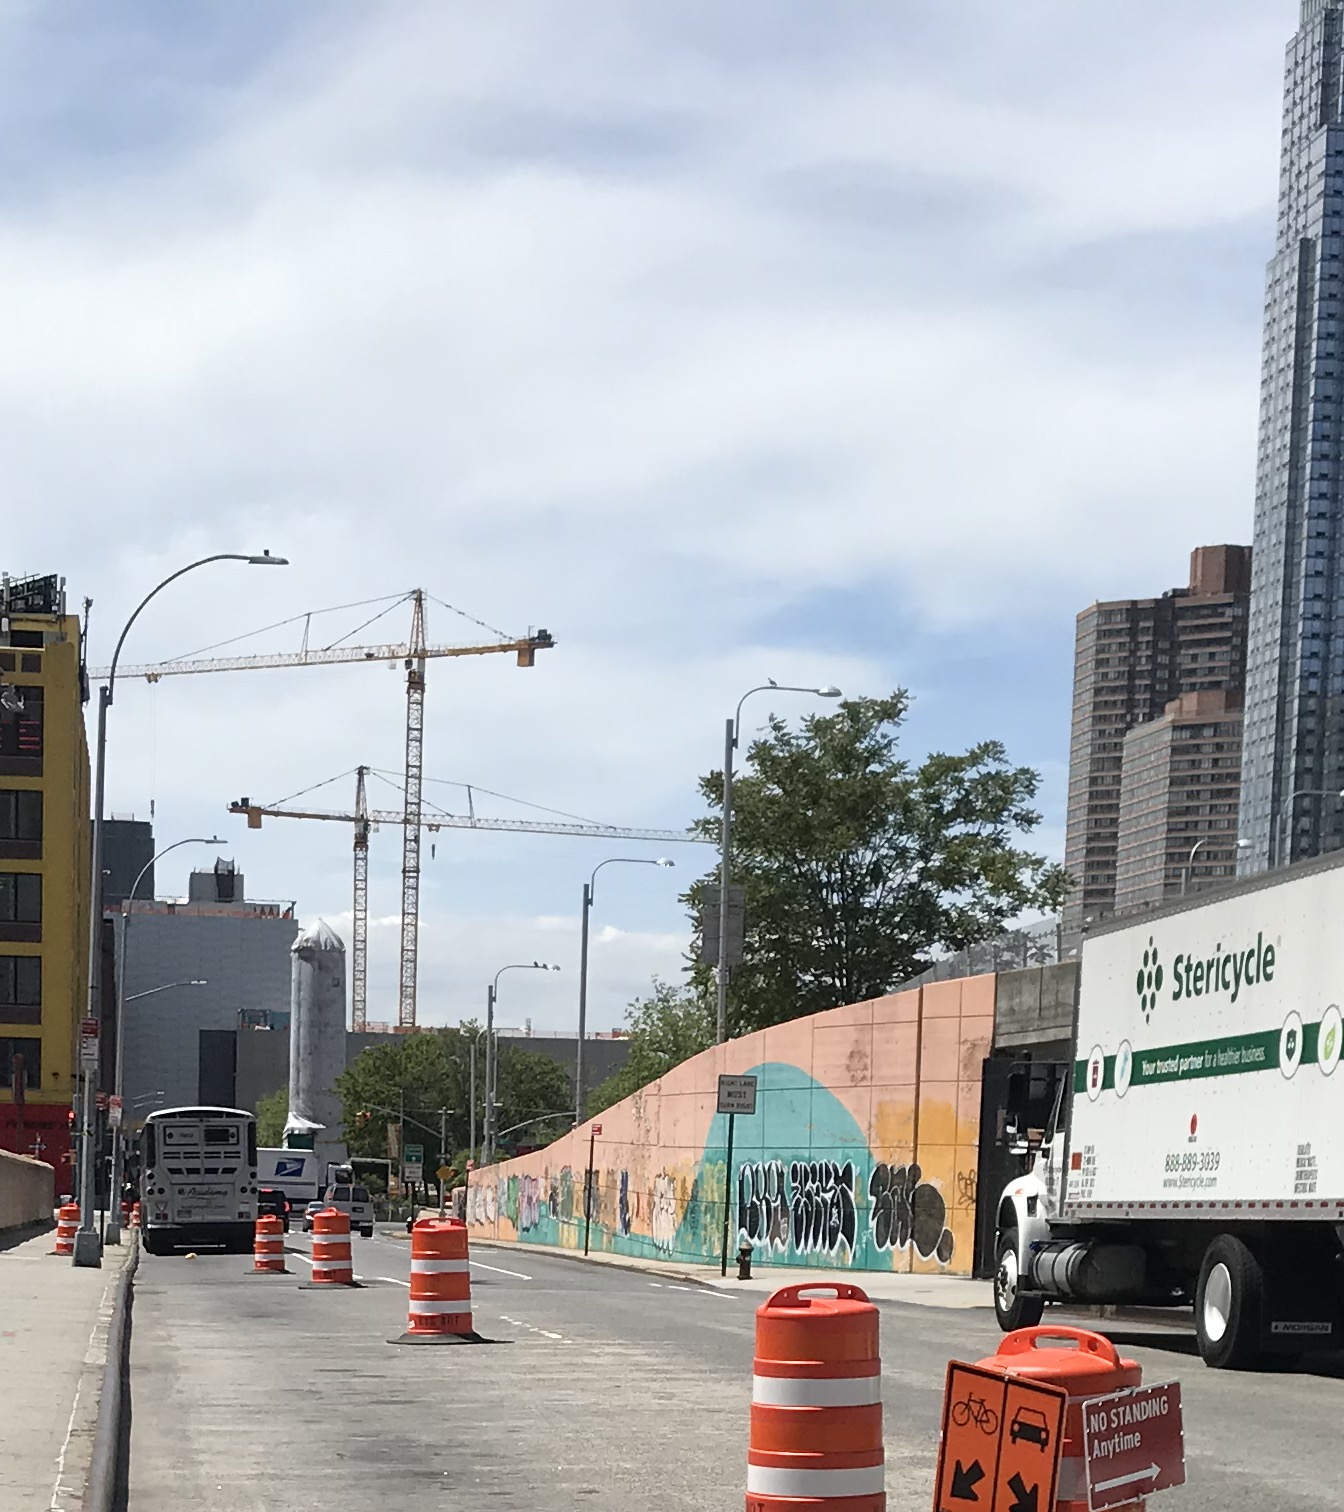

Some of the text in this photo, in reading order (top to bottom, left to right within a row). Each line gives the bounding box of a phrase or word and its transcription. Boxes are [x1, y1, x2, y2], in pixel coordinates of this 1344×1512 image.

[1172, 931, 1276, 1003] Stericycle
[1142, 1059, 1156, 1076] Your
[1156, 1054, 1180, 1075] trusted
[1179, 1055, 1204, 1076] partner
[727, 1091, 747, 1099] MUST
[1164, 1151, 1221, 1172] 888-889-3039
[1090, 1397, 1168, 1434] NO STANDING
[1092, 1431, 1142, 1460] Anytime
